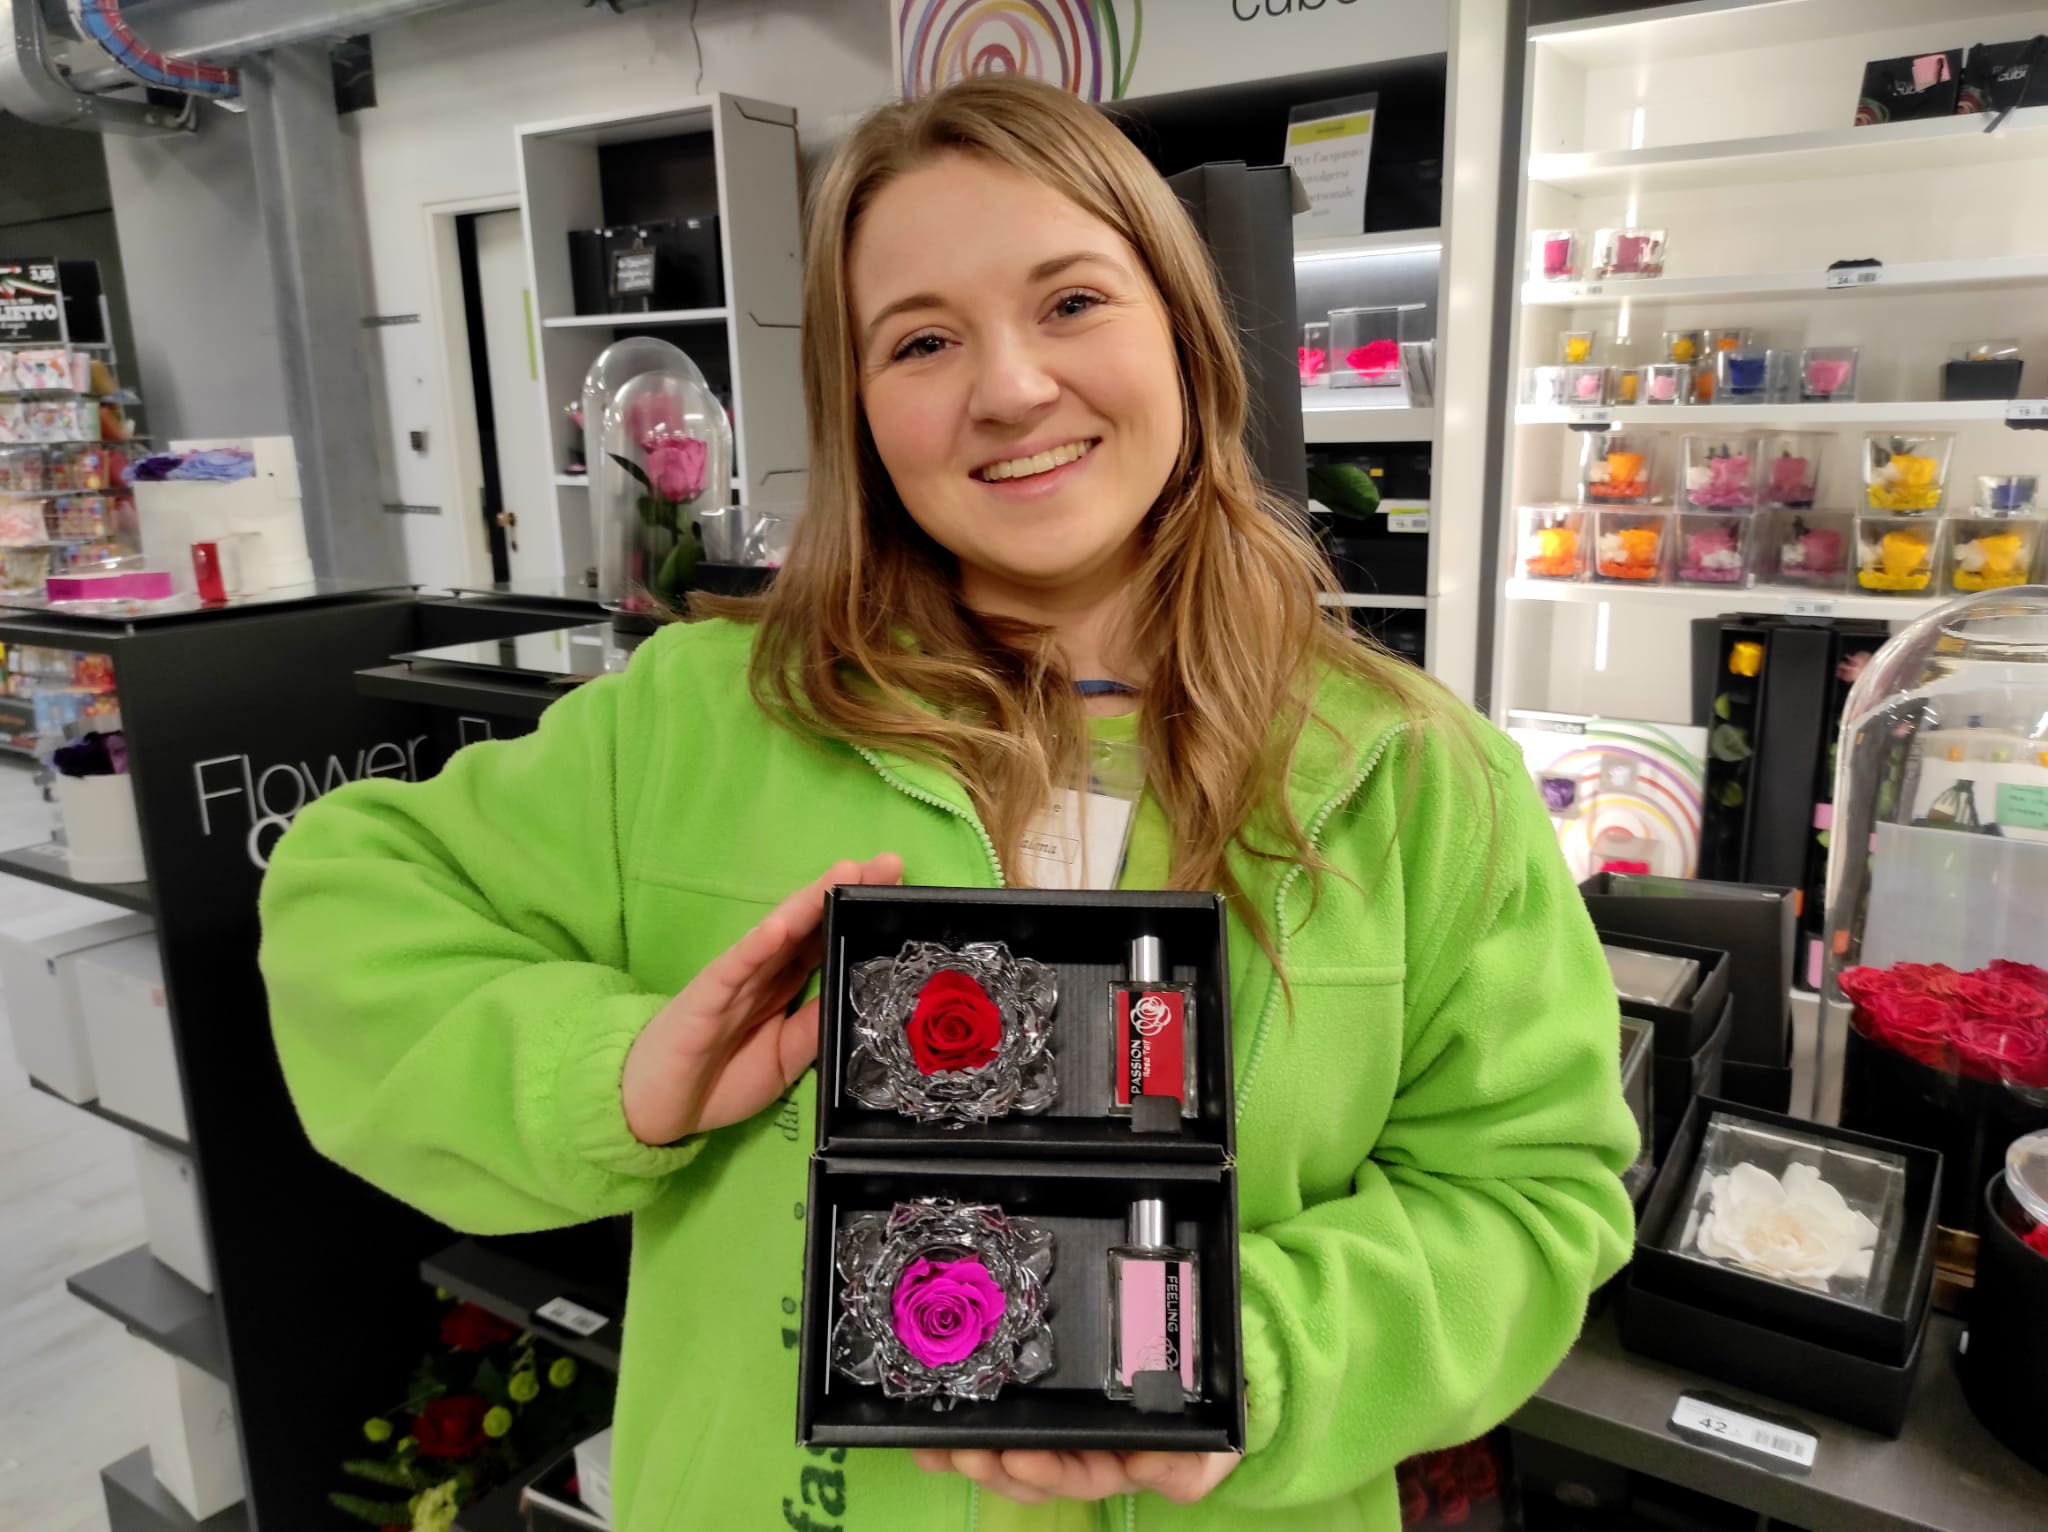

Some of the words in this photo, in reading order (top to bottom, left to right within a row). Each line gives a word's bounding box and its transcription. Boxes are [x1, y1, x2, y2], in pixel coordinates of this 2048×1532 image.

[193, 734, 428, 836] Flower
[1130, 1039, 1142, 1094] PASSION
[1166, 1275, 1179, 1333] FEELING
